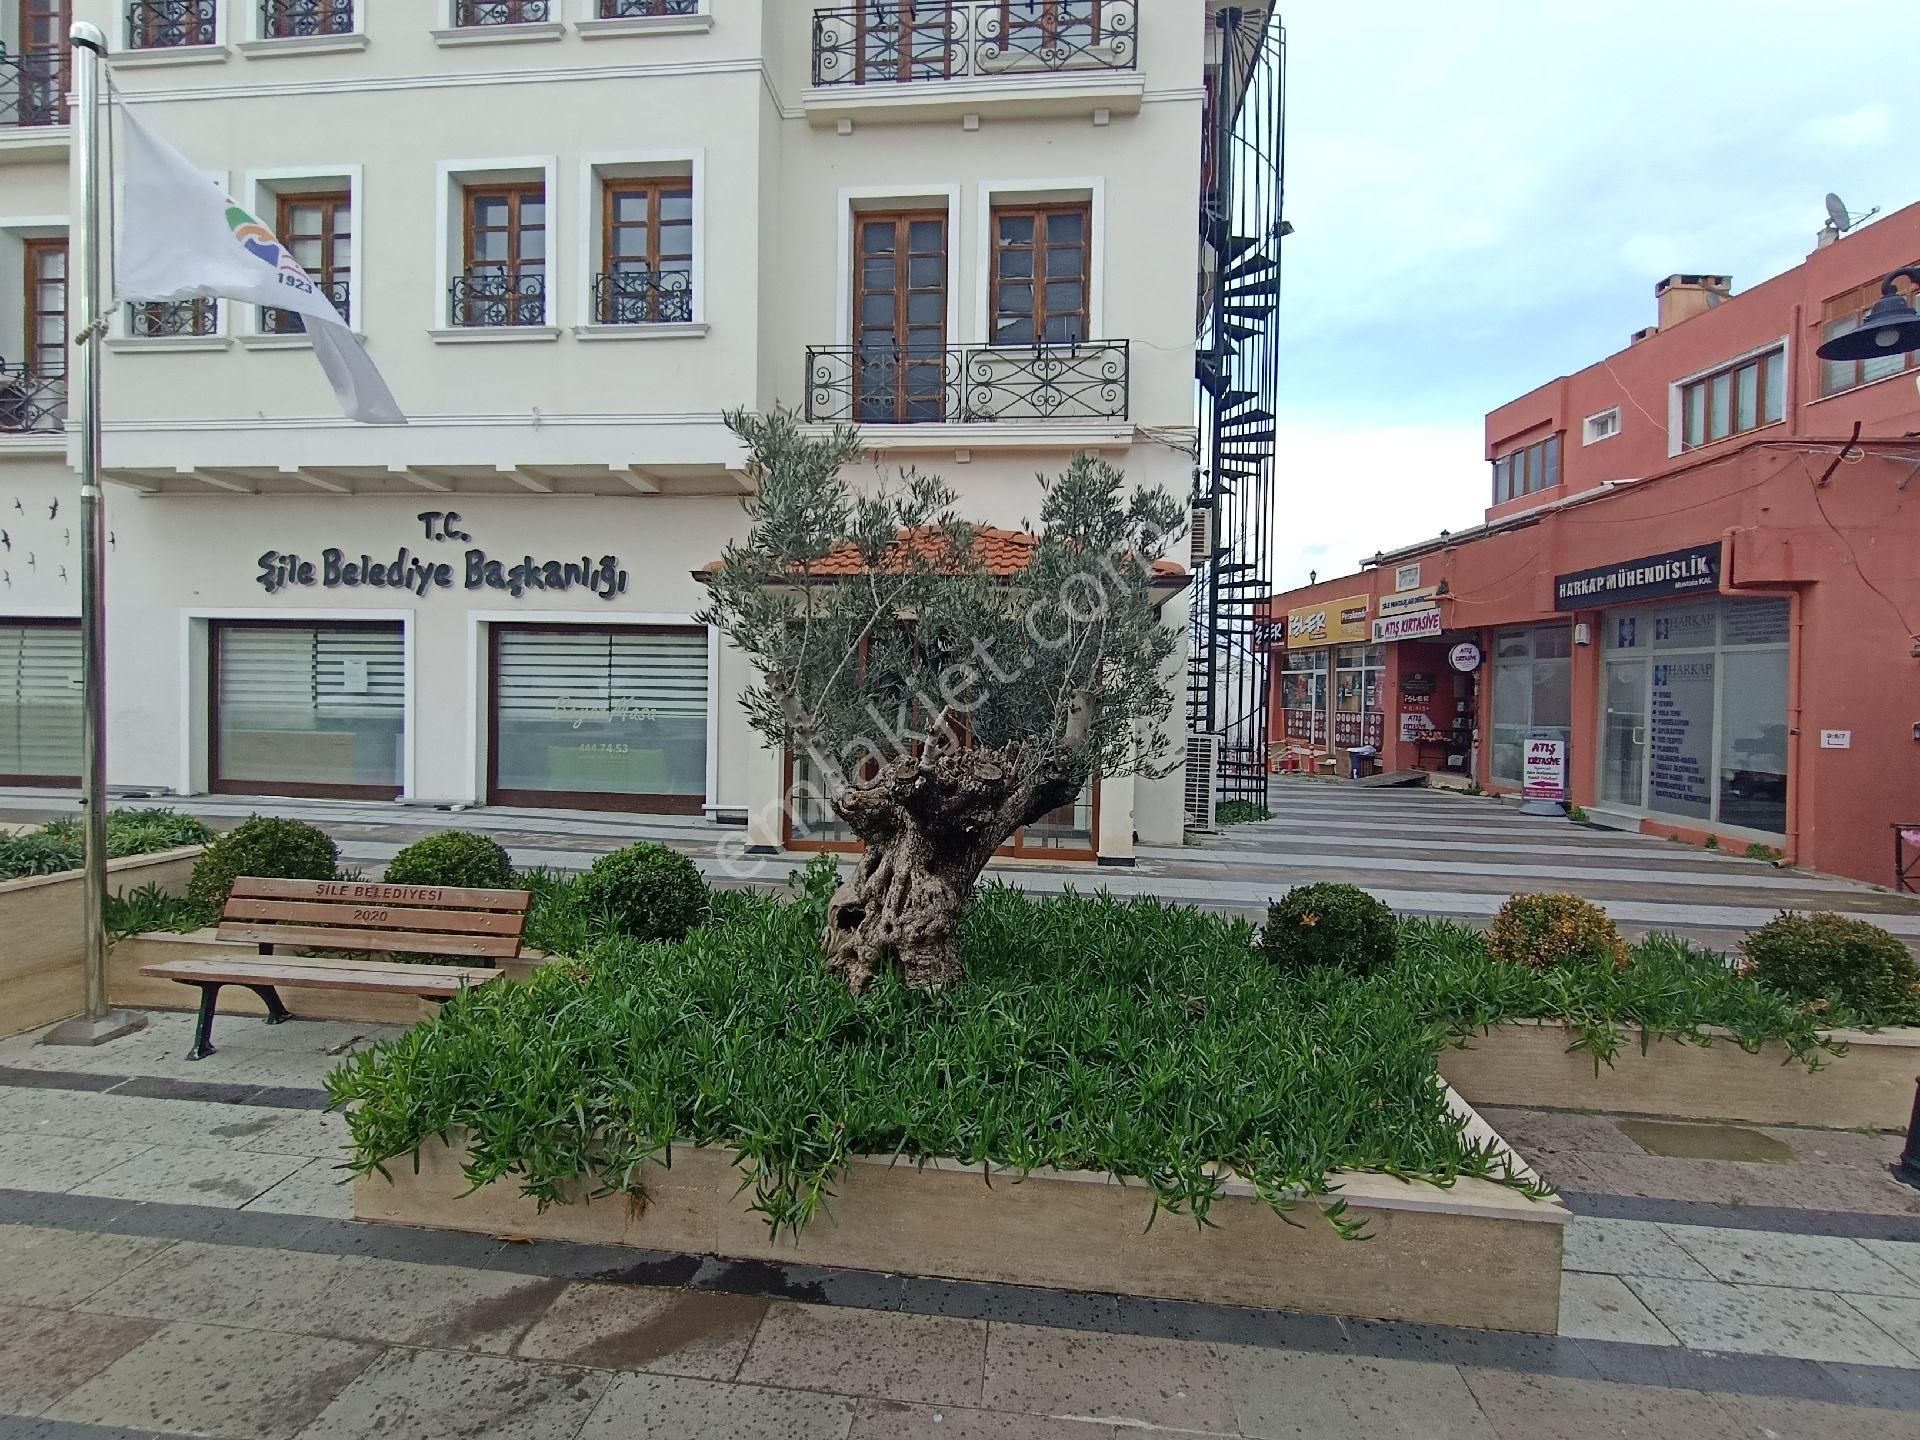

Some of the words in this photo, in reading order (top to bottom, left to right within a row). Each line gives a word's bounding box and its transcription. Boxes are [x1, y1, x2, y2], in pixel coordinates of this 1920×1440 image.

[277, 271, 313, 295] 1923
[418, 511, 472, 542] T.C.
[256, 550, 317, 593] Şile
[322, 547, 455, 597] Belediye
[465, 548, 630, 600] Başkanlığı
[1559, 575, 1604, 598] HARKAP
[1605, 554, 1711, 590] MÜHENDİSLİK
[1385, 621, 1400, 638] ATIŞ
[1401, 612, 1440, 633] KIRTASİYE
[1668, 663, 1713, 676] HARKAP
[599, 743, 613, 753] 74
[615, 744, 629, 754] 53
[1531, 742, 1556, 755] ATIŞ
[1527, 756, 1561, 766] KIRTASİYE
[315, 883, 348, 897] ŞİLE
[353, 884, 443, 901] BELEDİYESİ
[353, 909, 389, 922] 2020
